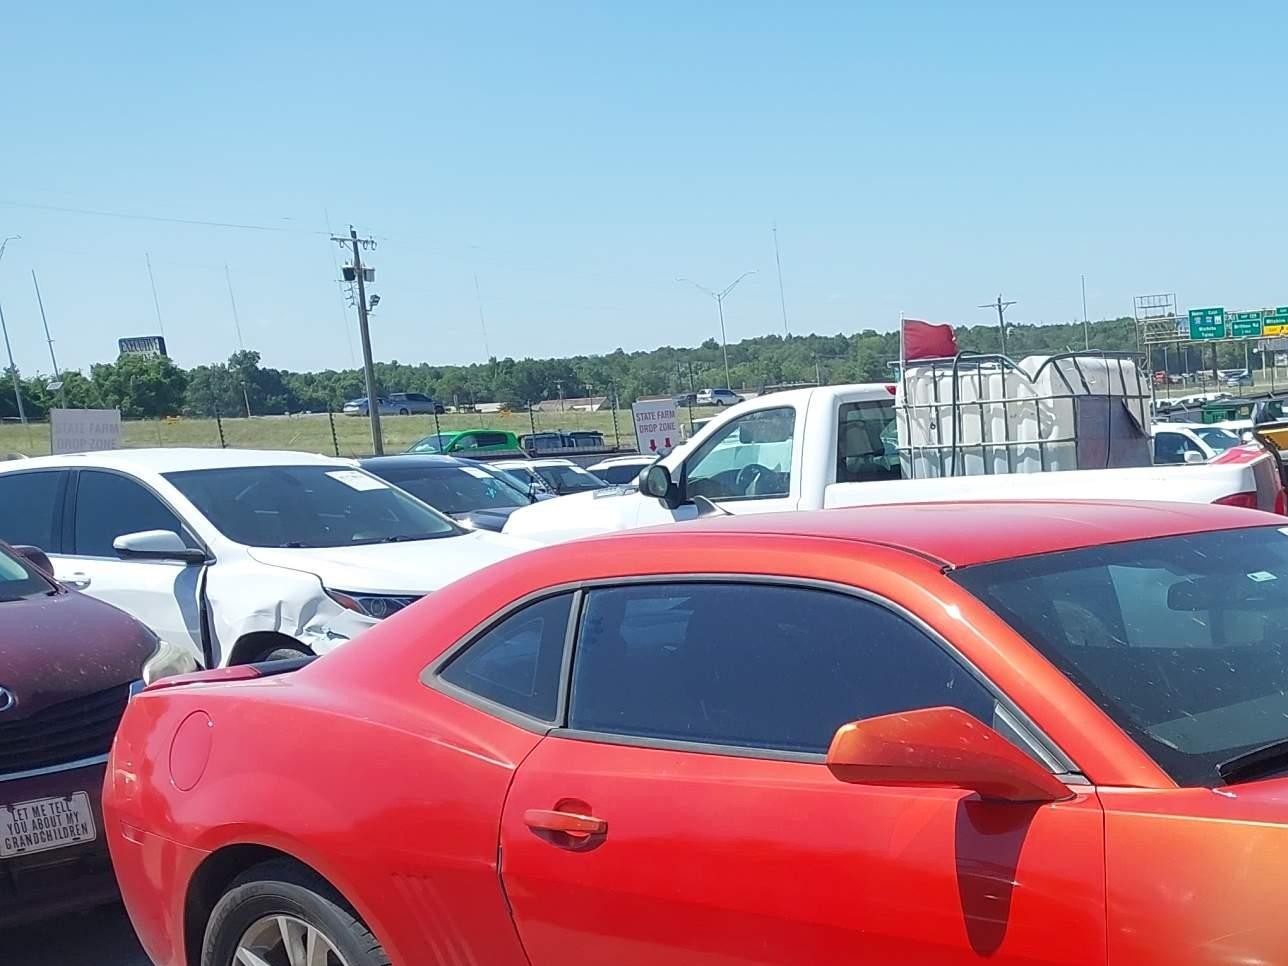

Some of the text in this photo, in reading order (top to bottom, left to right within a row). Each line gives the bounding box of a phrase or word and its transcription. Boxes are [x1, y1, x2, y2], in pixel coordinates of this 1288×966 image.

[636, 409, 676, 422] STATE FARM
[88, 422, 120, 434] FARM
[640, 422, 676, 434] DROP ZONE
[12, 800, 72, 822] LET ME TELL
[7, 810, 79, 836] YOU ABOUT MY
[5, 822, 89, 850] GRANDCHILDREN
